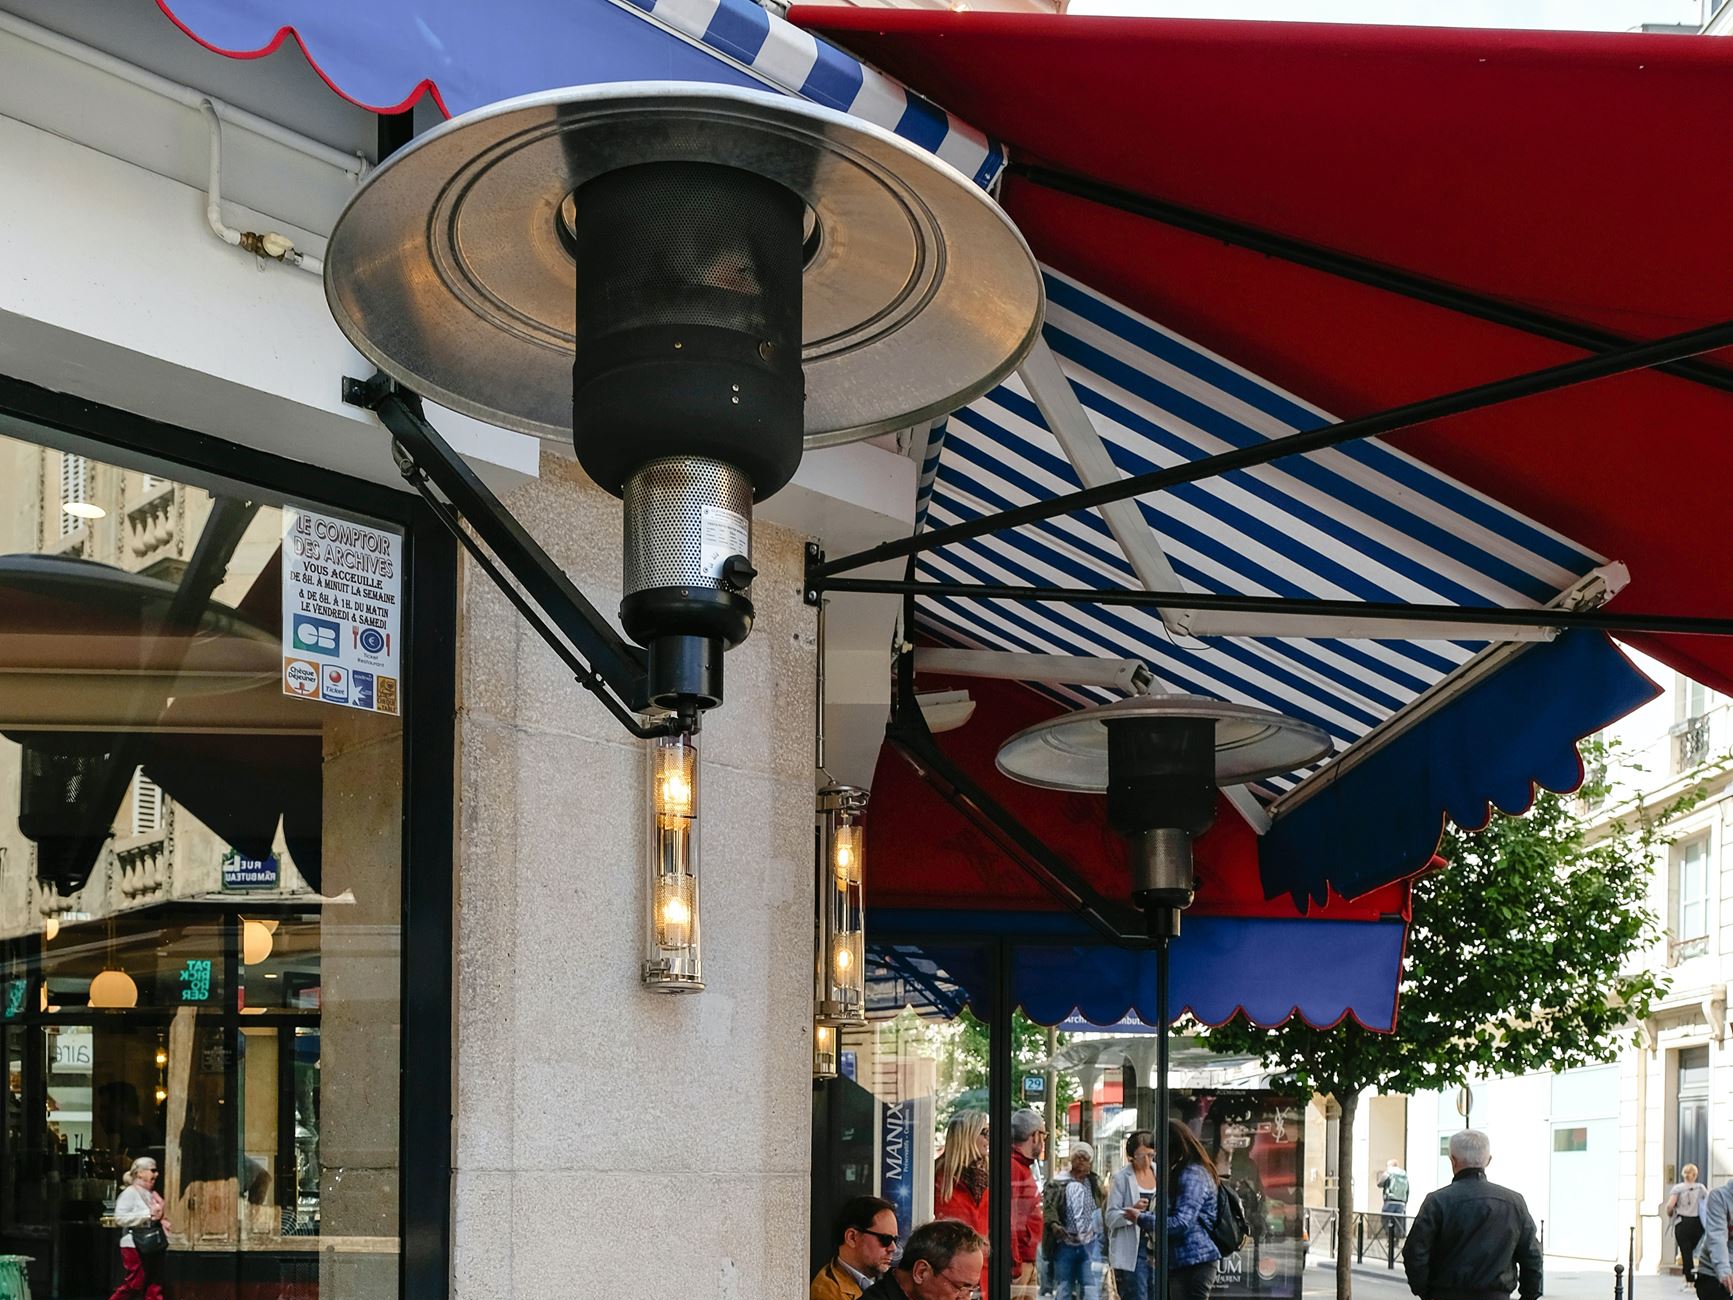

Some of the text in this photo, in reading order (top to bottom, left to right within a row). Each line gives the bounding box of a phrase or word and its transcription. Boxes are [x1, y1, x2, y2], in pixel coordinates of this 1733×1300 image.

[297, 514, 390, 556] LE COMPTOIR
[294, 536, 394, 579] DES ARCHIVES
[290, 571, 300, 582] DE
[324, 579, 348, 593] MINUIT
[351, 584, 362, 596] LA
[363, 589, 396, 605] SEMAINE
[302, 561, 383, 590] VOUS ACCEUILLE
[298, 588, 304, 598] &
[307, 590, 318, 602] DE
[354, 602, 365, 612] DU
[366, 604, 389, 618] MATIN
[301, 601, 387, 630] LE VENDREDI & SAMEDI
[326, 686, 345, 696] Ticket
[1028, 1078, 1041, 1088] 29
[886, 1103, 903, 1180] MANIX
